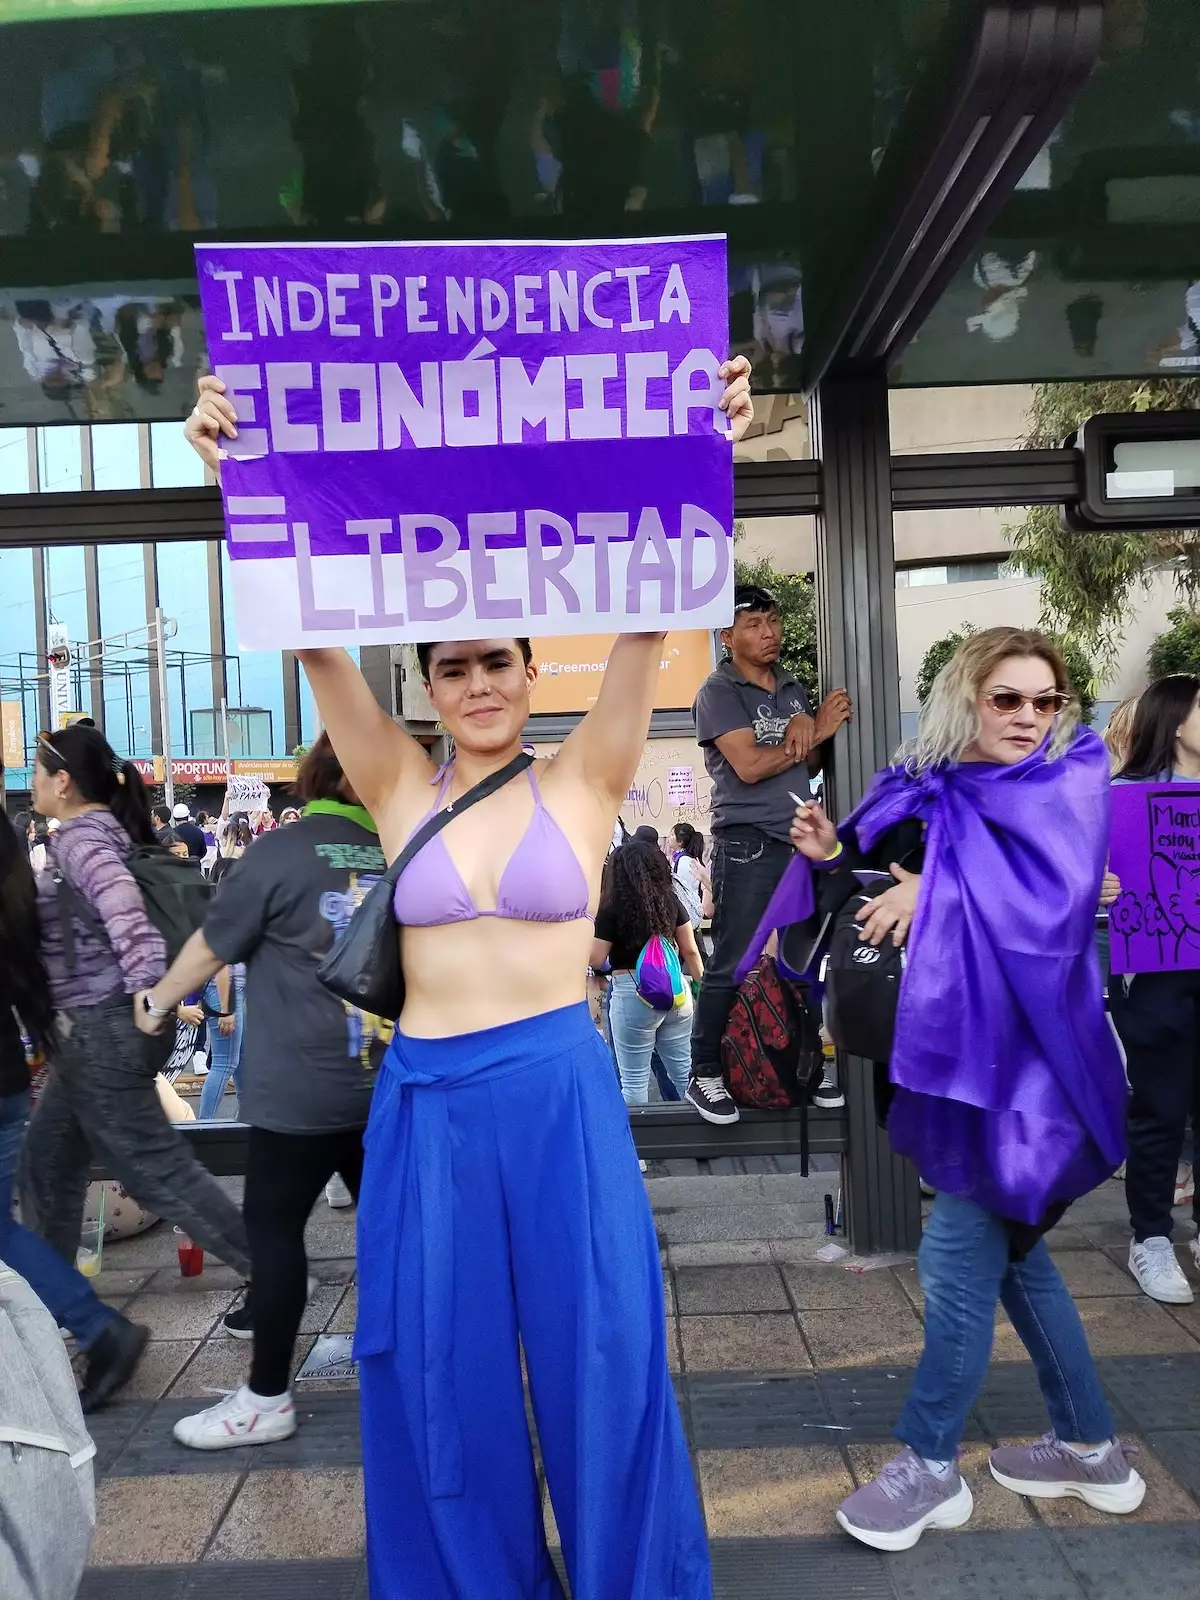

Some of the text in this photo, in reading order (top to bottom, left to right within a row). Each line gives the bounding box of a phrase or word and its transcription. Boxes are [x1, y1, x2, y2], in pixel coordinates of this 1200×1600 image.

[214, 264, 691, 341] INDEPENDENCIA
[215, 337, 728, 457] ECONÓMICA
[294, 504, 729, 631] LIBERTAD
[56, 672, 68, 712] UNIV
[1158, 832, 1195, 851] estoy
